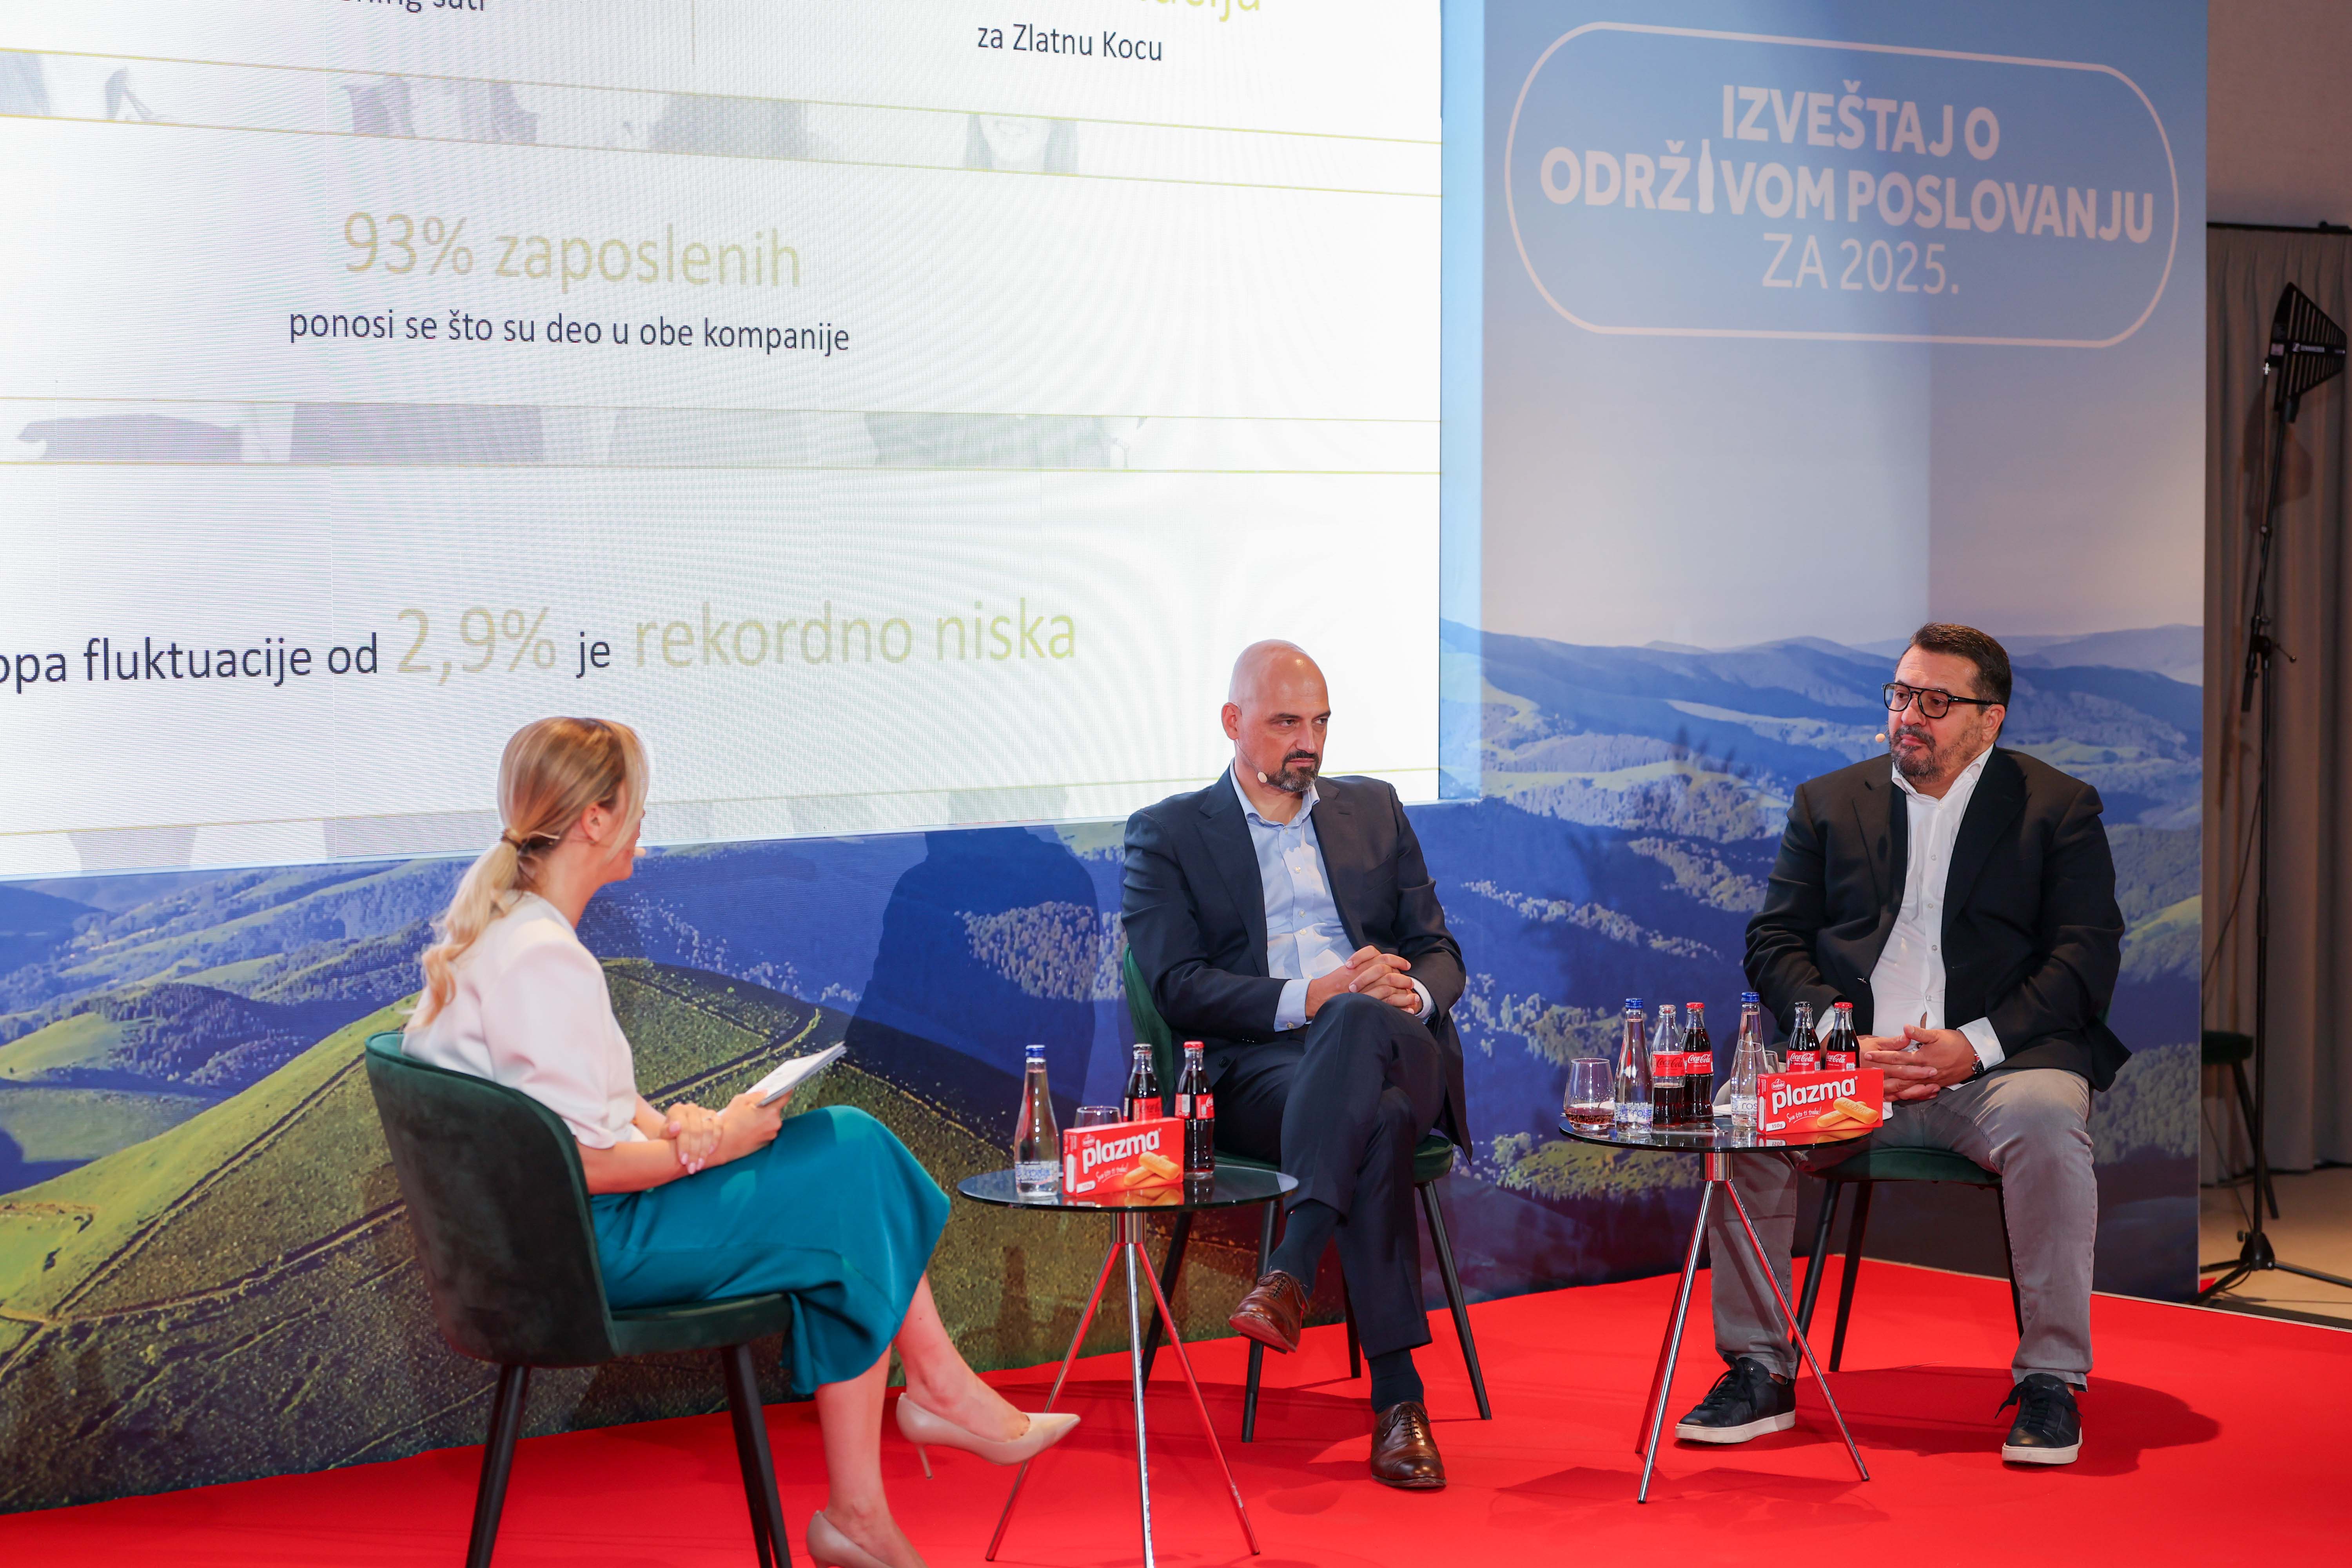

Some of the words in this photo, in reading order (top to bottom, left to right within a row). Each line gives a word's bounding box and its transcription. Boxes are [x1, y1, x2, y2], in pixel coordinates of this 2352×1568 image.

[977, 27, 1004, 49] za
[1013, 23, 1093, 56] Zlatnu
[1103, 31, 1162, 62] Kocu
[1723, 80, 1954, 156] IZVEŠTAJ
[1964, 107, 2000, 160] O
[1848, 171, 2153, 243] POSLOVANJU
[343, 211, 474, 275] 93%
[495, 224, 800, 293] zaposlenih
[1762, 233, 1828, 289] ZA
[1840, 238, 1959, 294] 2025.
[290, 309, 394, 343] ponosi
[405, 316, 438, 340] se
[448, 309, 494, 341] što
[503, 319, 535, 342] su
[546, 313, 603, 344] deo
[612, 323, 629, 345] u
[639, 316, 693, 347] obe
[704, 318, 850, 358] kompanije
[83, 637, 312, 688] fluktuacije
[327, 632, 378, 675] od
[397, 607, 556, 685] 2,9%
[575, 631, 611, 679] je
[635, 600, 914, 668] rekordno
[937, 597, 1076, 661] niska
[1688, 1054, 1710, 1063] Coca-Cola
[1790, 1053, 1815, 1062] Coca-Cola
[1772, 1078, 1856, 1115] plazma
[1082, 1130, 1160, 1174] plazma
